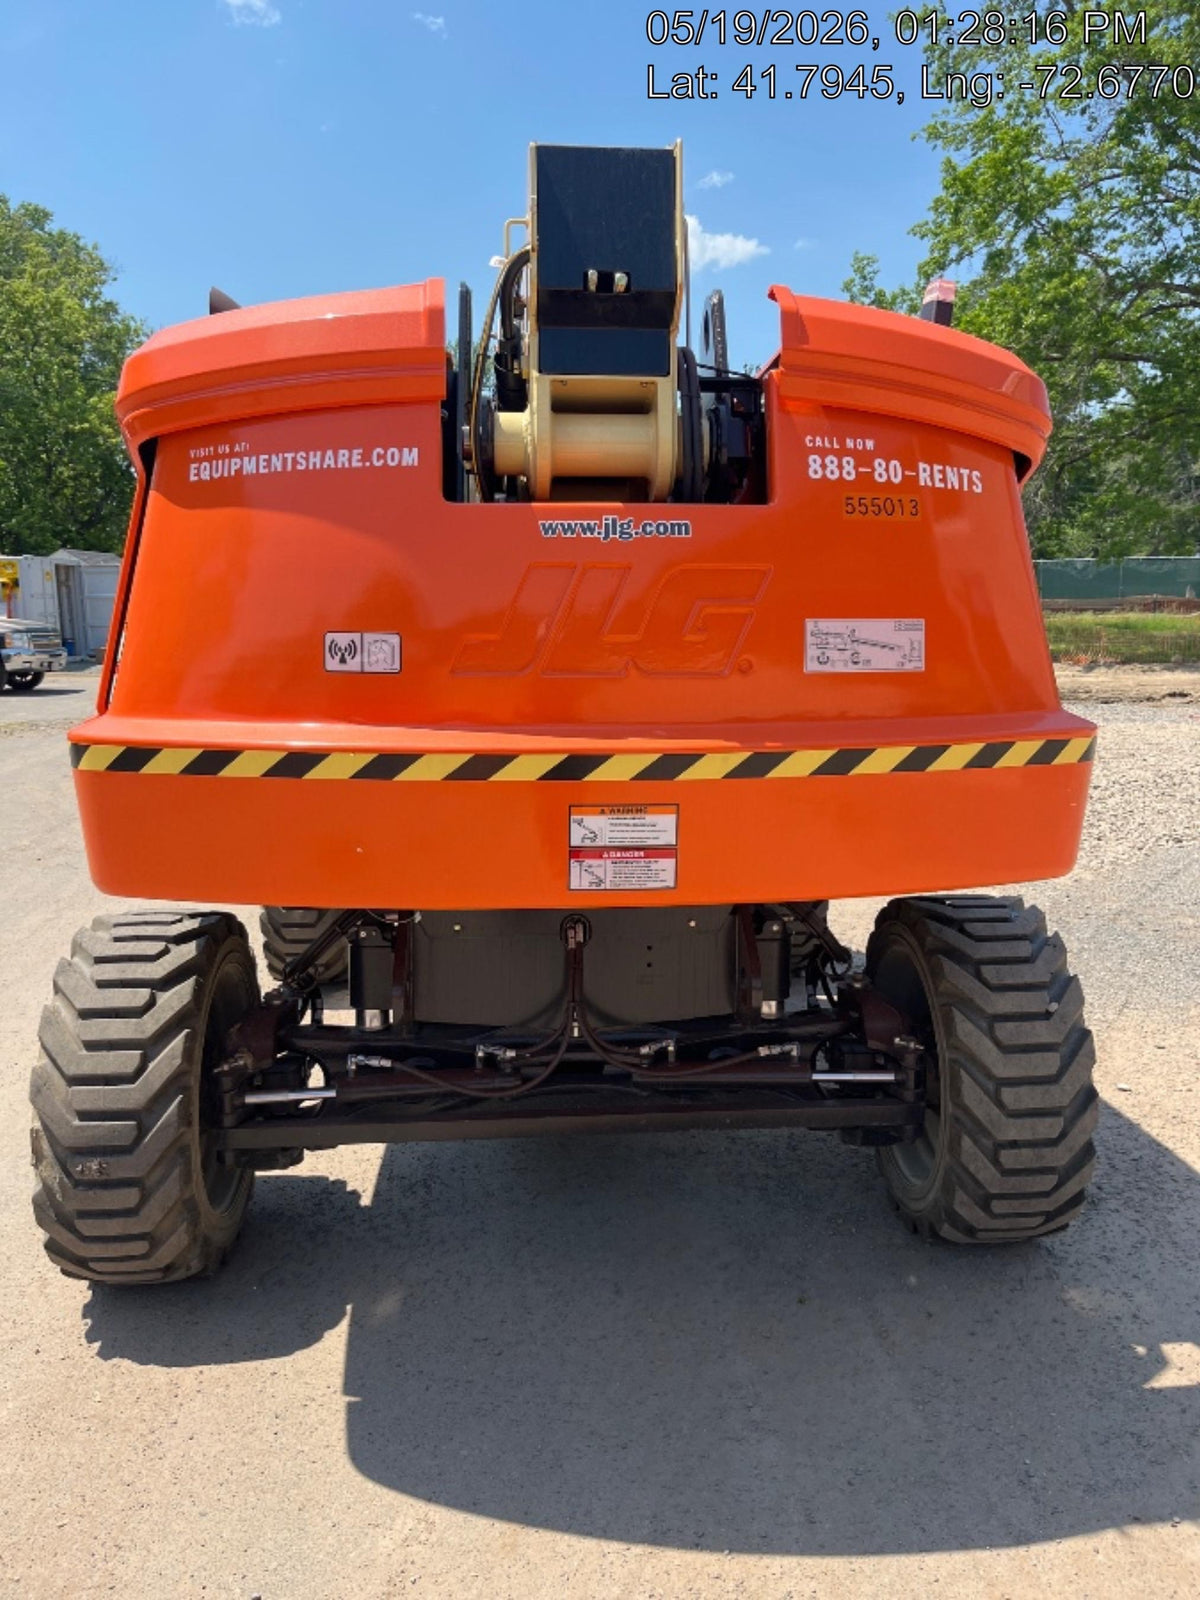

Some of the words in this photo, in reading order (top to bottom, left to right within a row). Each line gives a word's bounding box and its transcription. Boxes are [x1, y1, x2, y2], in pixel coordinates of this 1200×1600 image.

[189, 446, 214, 458] VISIT
[218, 444, 230, 454] US
[233, 442, 250, 452] AT:
[805, 435, 840, 449] CALL
[846, 438, 875, 450] NOW
[189, 447, 419, 482] EQUIPMENTSHARE.COM
[807, 454, 983, 493] 888-80-RENTS
[844, 496, 920, 517] 555013
[539, 516, 692, 541] www.jlg.com
[450, 561, 774, 678] JLG
